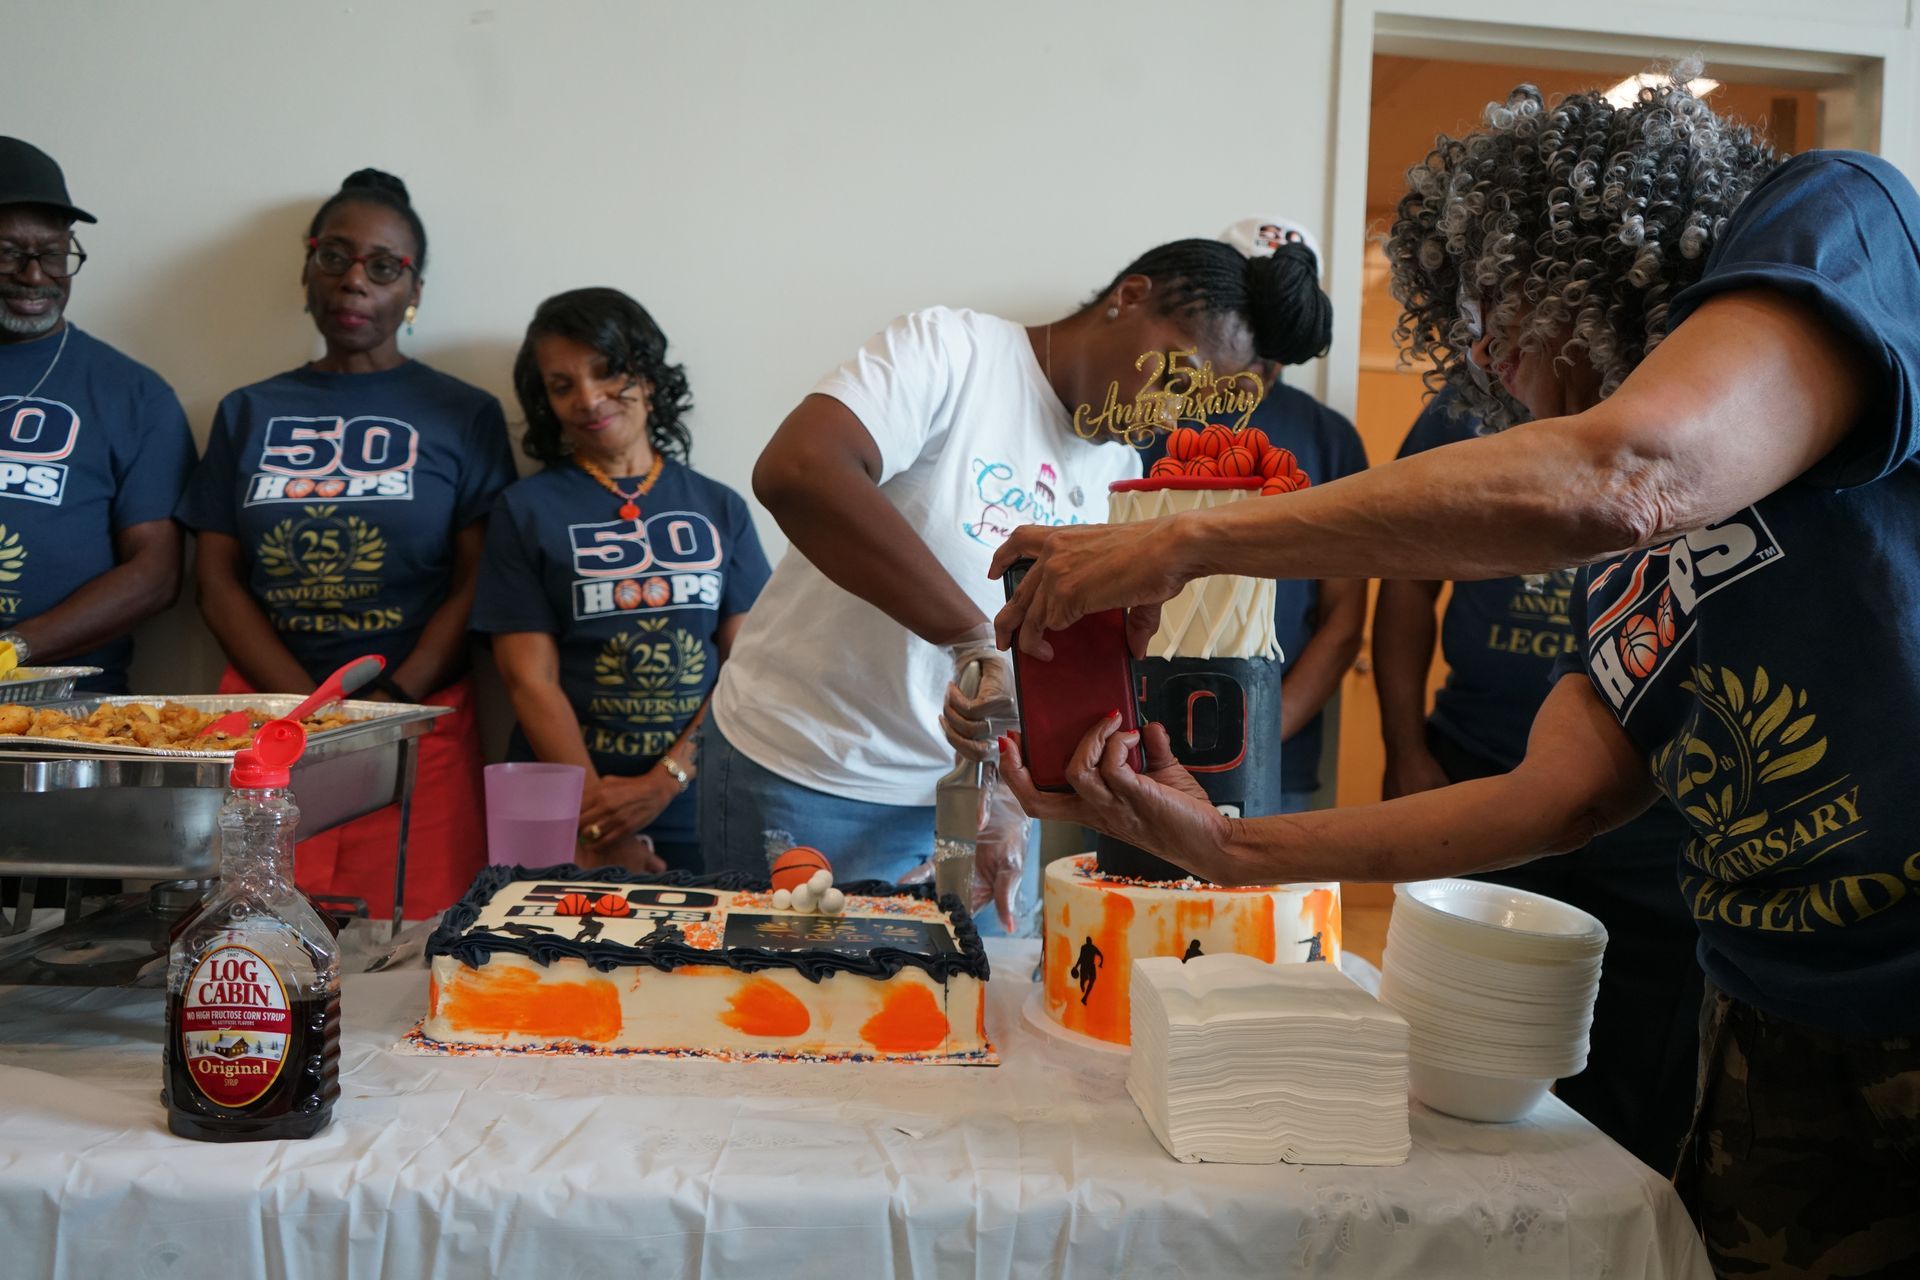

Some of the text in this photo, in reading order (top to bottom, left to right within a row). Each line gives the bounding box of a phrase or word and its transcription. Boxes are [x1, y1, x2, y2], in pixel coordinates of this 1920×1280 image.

[1134, 346, 1214, 398] 25th
[259, 415, 419, 477] 50
[253, 470, 408, 500] HOOPS
[568, 511, 722, 577] 50
[1755, 546, 1776, 561] TM
[583, 574, 720, 614] HOOPS
[210, 959, 258, 982] LOG
[199, 983, 270, 1006] CABIN
[187, 1011, 286, 1022] NO HIGH FRUCTOSE CORN SYRUP
[199, 1060, 268, 1077] Original
[224, 1079, 239, 1087] SYRUP
